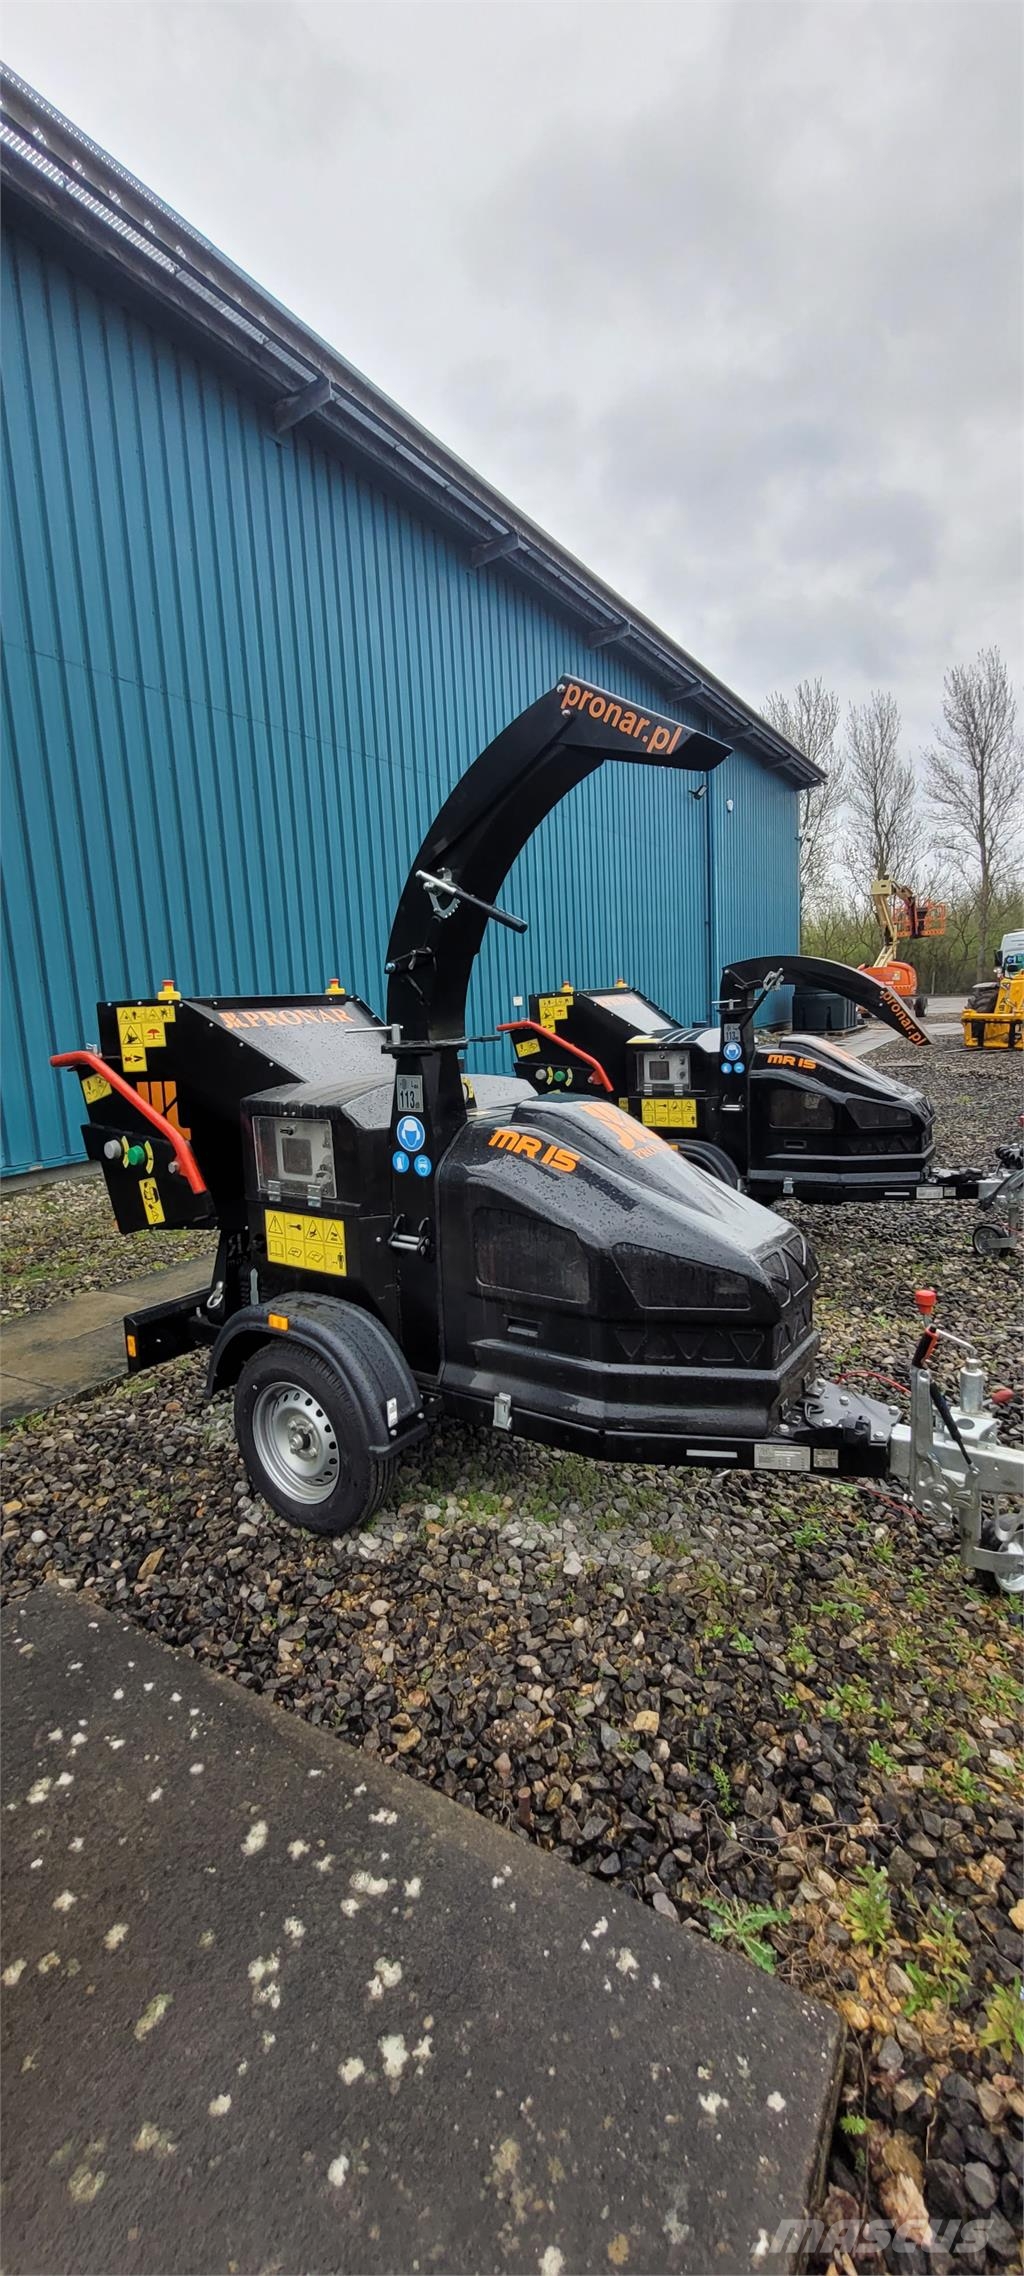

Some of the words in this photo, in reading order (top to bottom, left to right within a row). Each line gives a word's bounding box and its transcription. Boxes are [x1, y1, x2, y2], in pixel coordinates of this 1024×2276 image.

[560, 683, 683, 755] pronar.pl
[241, 1008, 355, 1028] PRONAR
[880, 991, 927, 1045] pronar.pl
[767, 1054, 796, 1066] MR
[400, 1090, 415, 1109] 113
[488, 1128, 542, 1159] MR
[540, 1144, 581, 1173] 15
